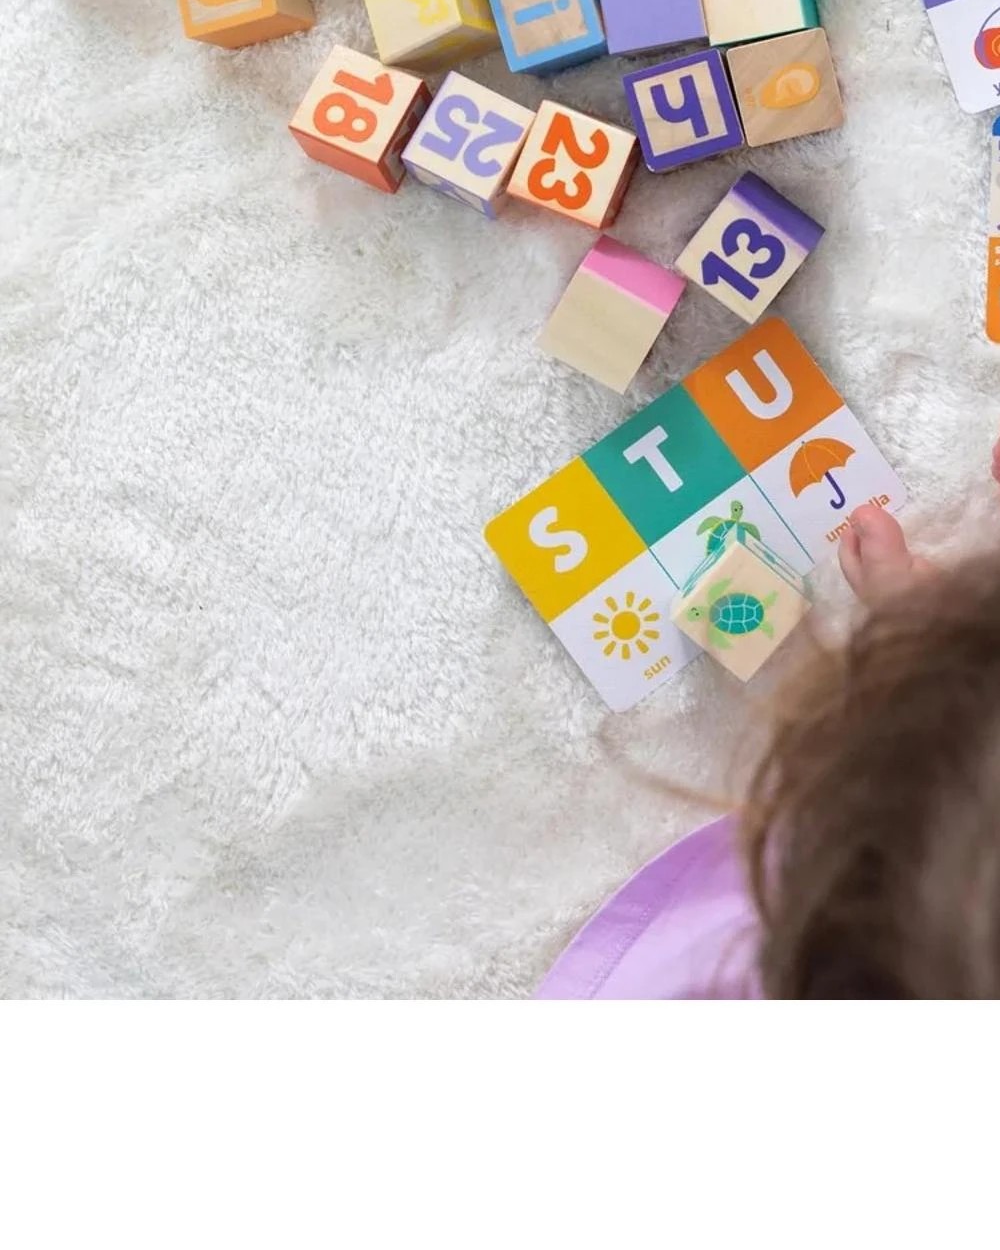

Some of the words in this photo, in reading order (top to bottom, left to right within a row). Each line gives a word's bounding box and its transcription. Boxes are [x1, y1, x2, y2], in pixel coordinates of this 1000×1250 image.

[313, 69, 395, 143] 18
[419, 94, 525, 178] 25
[527, 112, 610, 211] 23
[701, 218, 786, 301] 13
[528, 506, 588, 573] S
[622, 425, 684, 493] T
[725, 349, 793, 419] U
[643, 654, 672, 681] sun
